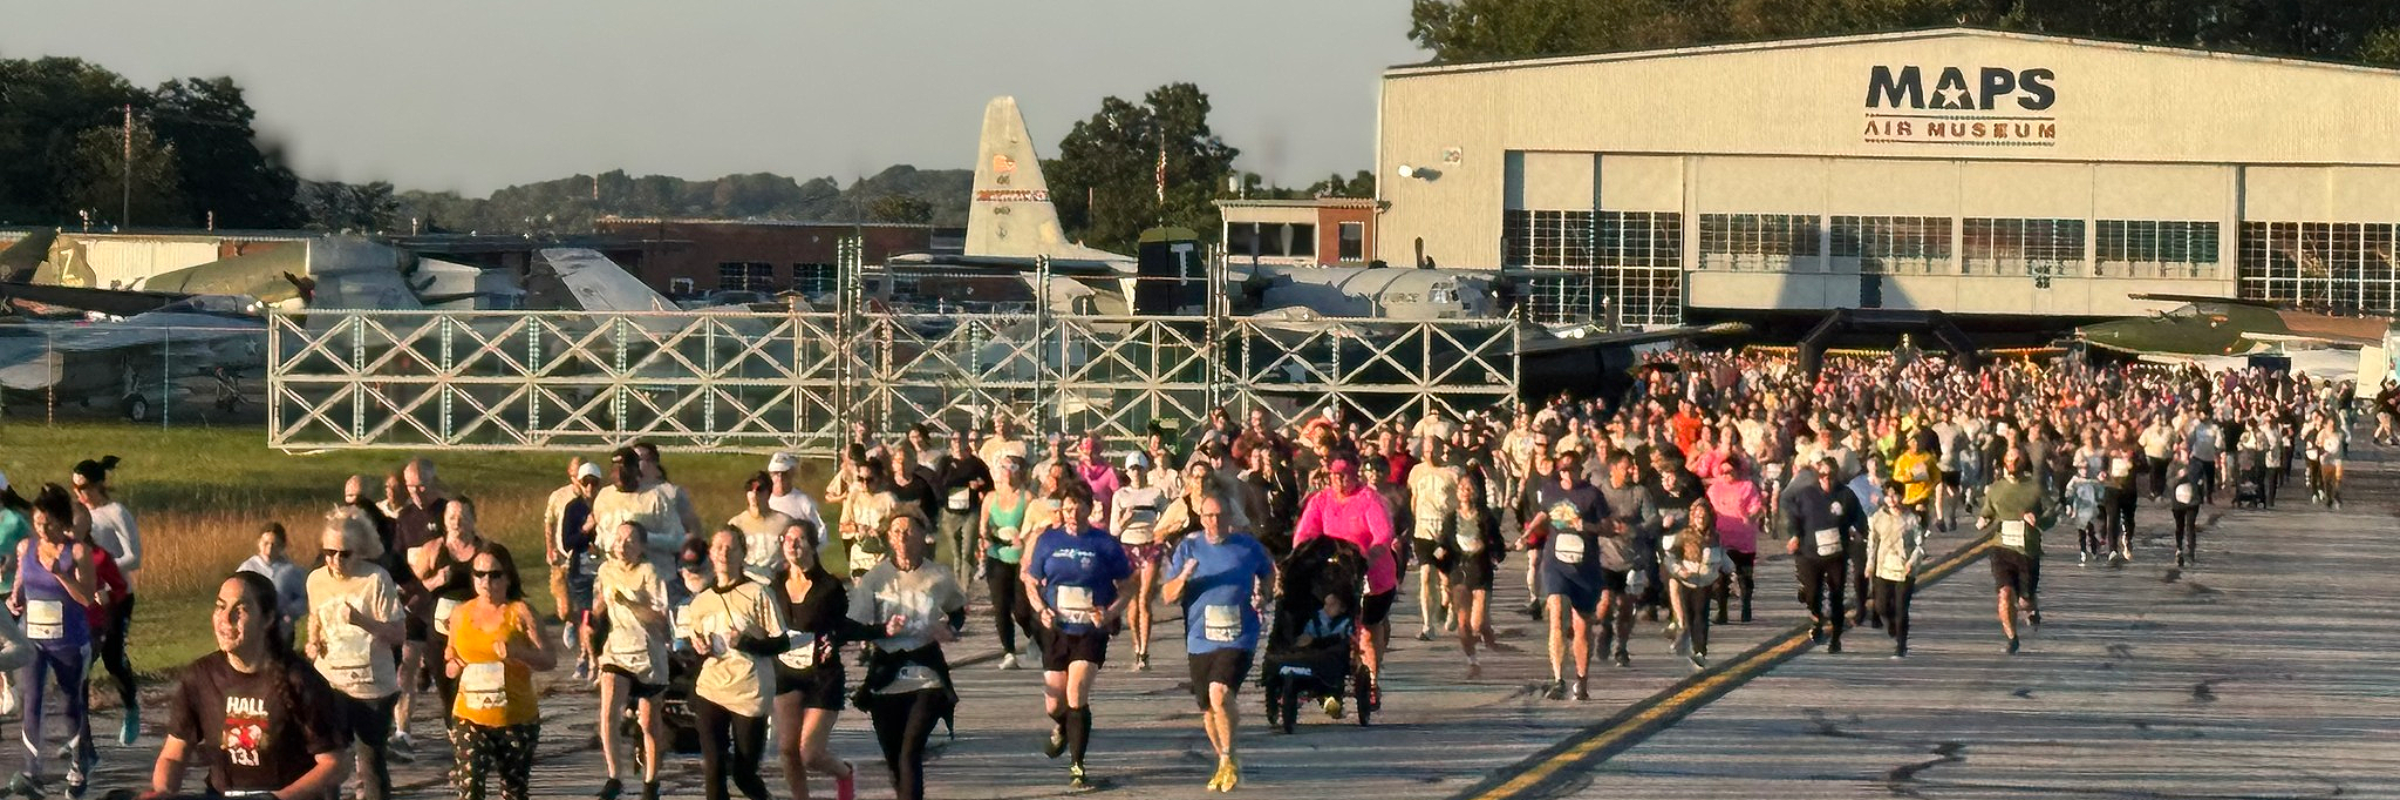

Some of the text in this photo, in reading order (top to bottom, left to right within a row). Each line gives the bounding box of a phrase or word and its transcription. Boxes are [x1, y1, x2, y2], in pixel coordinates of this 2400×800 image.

[1865, 65, 2056, 111] MAPS
[1864, 120, 2056, 139] AIR MUSEUM
[226, 696, 269, 716] HALL
